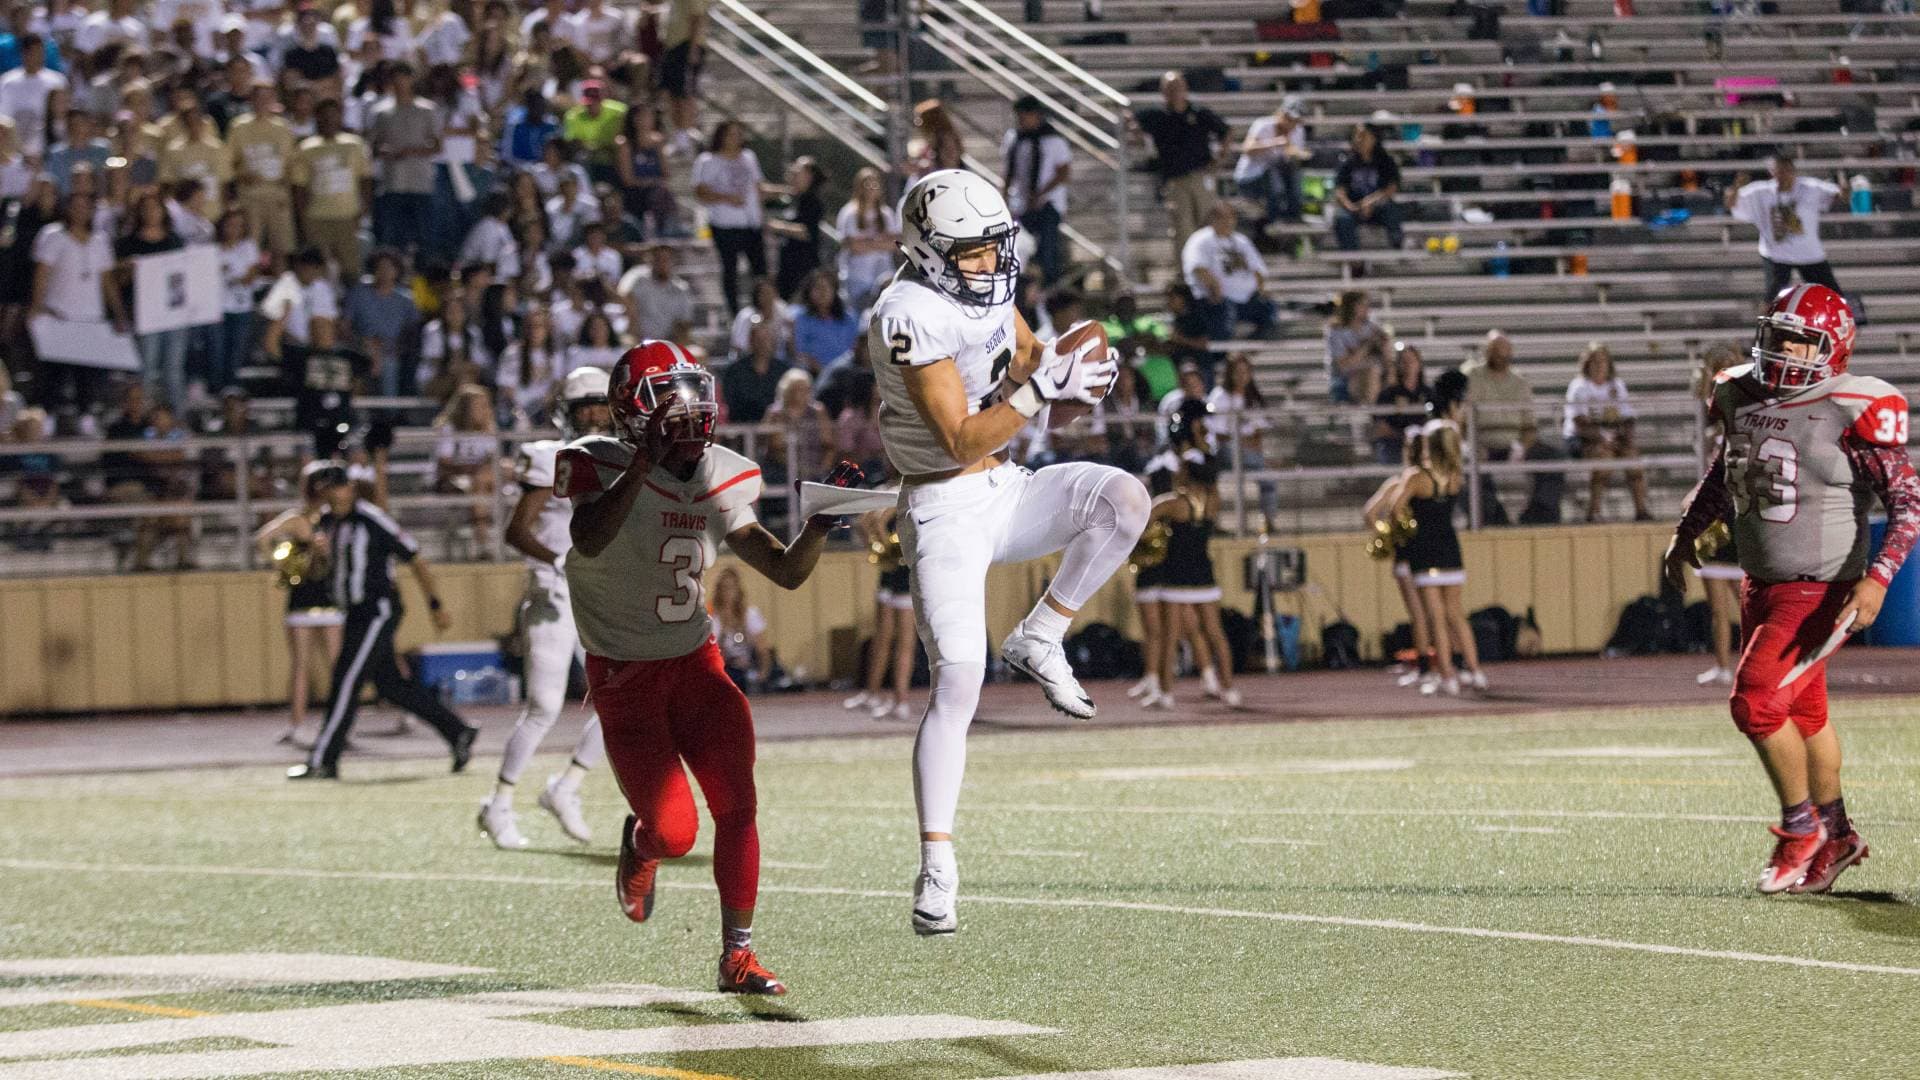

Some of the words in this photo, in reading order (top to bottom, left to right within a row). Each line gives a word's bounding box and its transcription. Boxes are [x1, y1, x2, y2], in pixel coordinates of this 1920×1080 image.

[890, 333, 913, 366] 2
[985, 324, 1008, 355] SEGUIN
[1743, 413, 1790, 431] TRAVIS
[1875, 409, 1908, 444] 33
[661, 511, 707, 531] TRAVIS
[655, 535, 704, 623] 3
